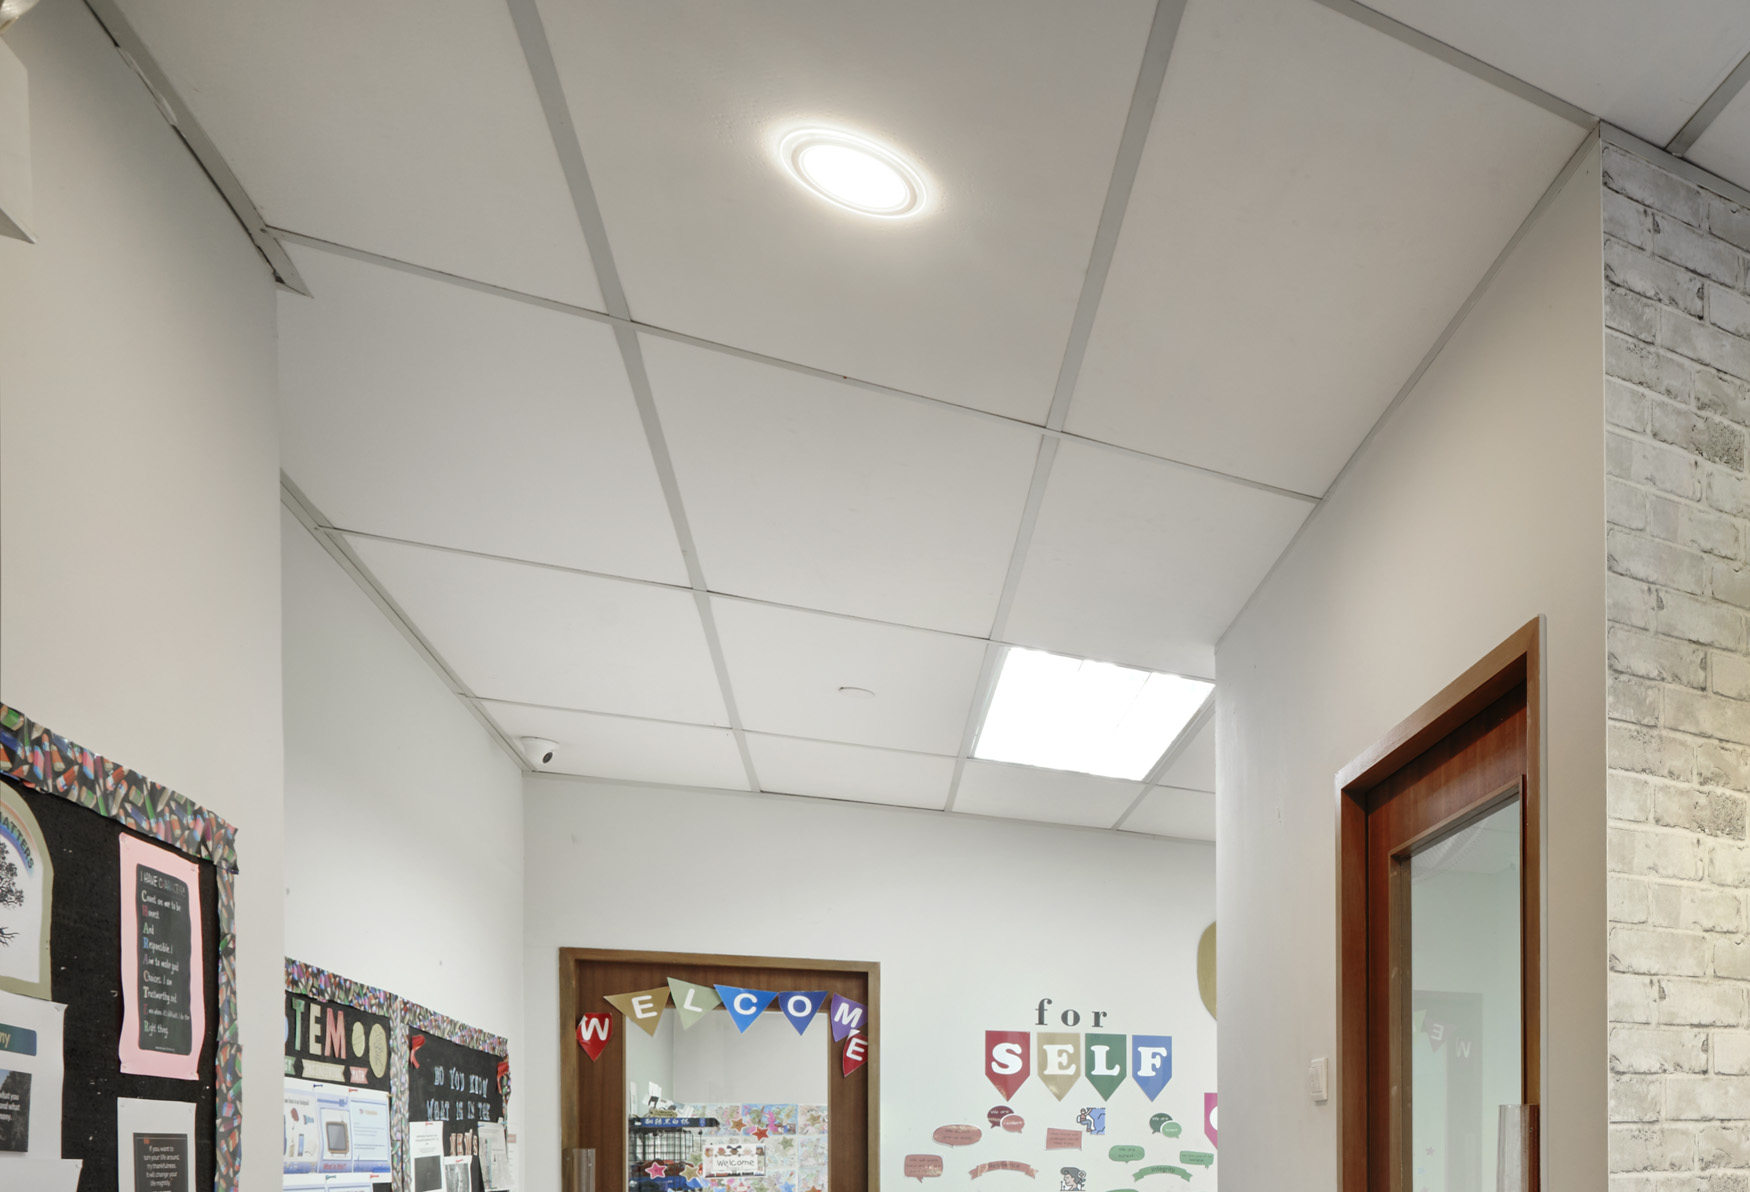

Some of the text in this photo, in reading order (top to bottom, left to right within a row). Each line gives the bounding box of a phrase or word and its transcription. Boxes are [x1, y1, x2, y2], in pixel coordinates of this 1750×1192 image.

[0, 811, 35, 869] ATTERS
[143, 922, 154, 935] And
[285, 997, 347, 1060] TEM
[581, 988, 868, 1062] WELCOME
[1035, 998, 1107, 1028] for
[991, 1042, 1167, 1077] SELF
[449, 1066, 465, 1092] YOU
[469, 1074, 489, 1099] KNOW
[426, 1098, 449, 1122] WHAT
